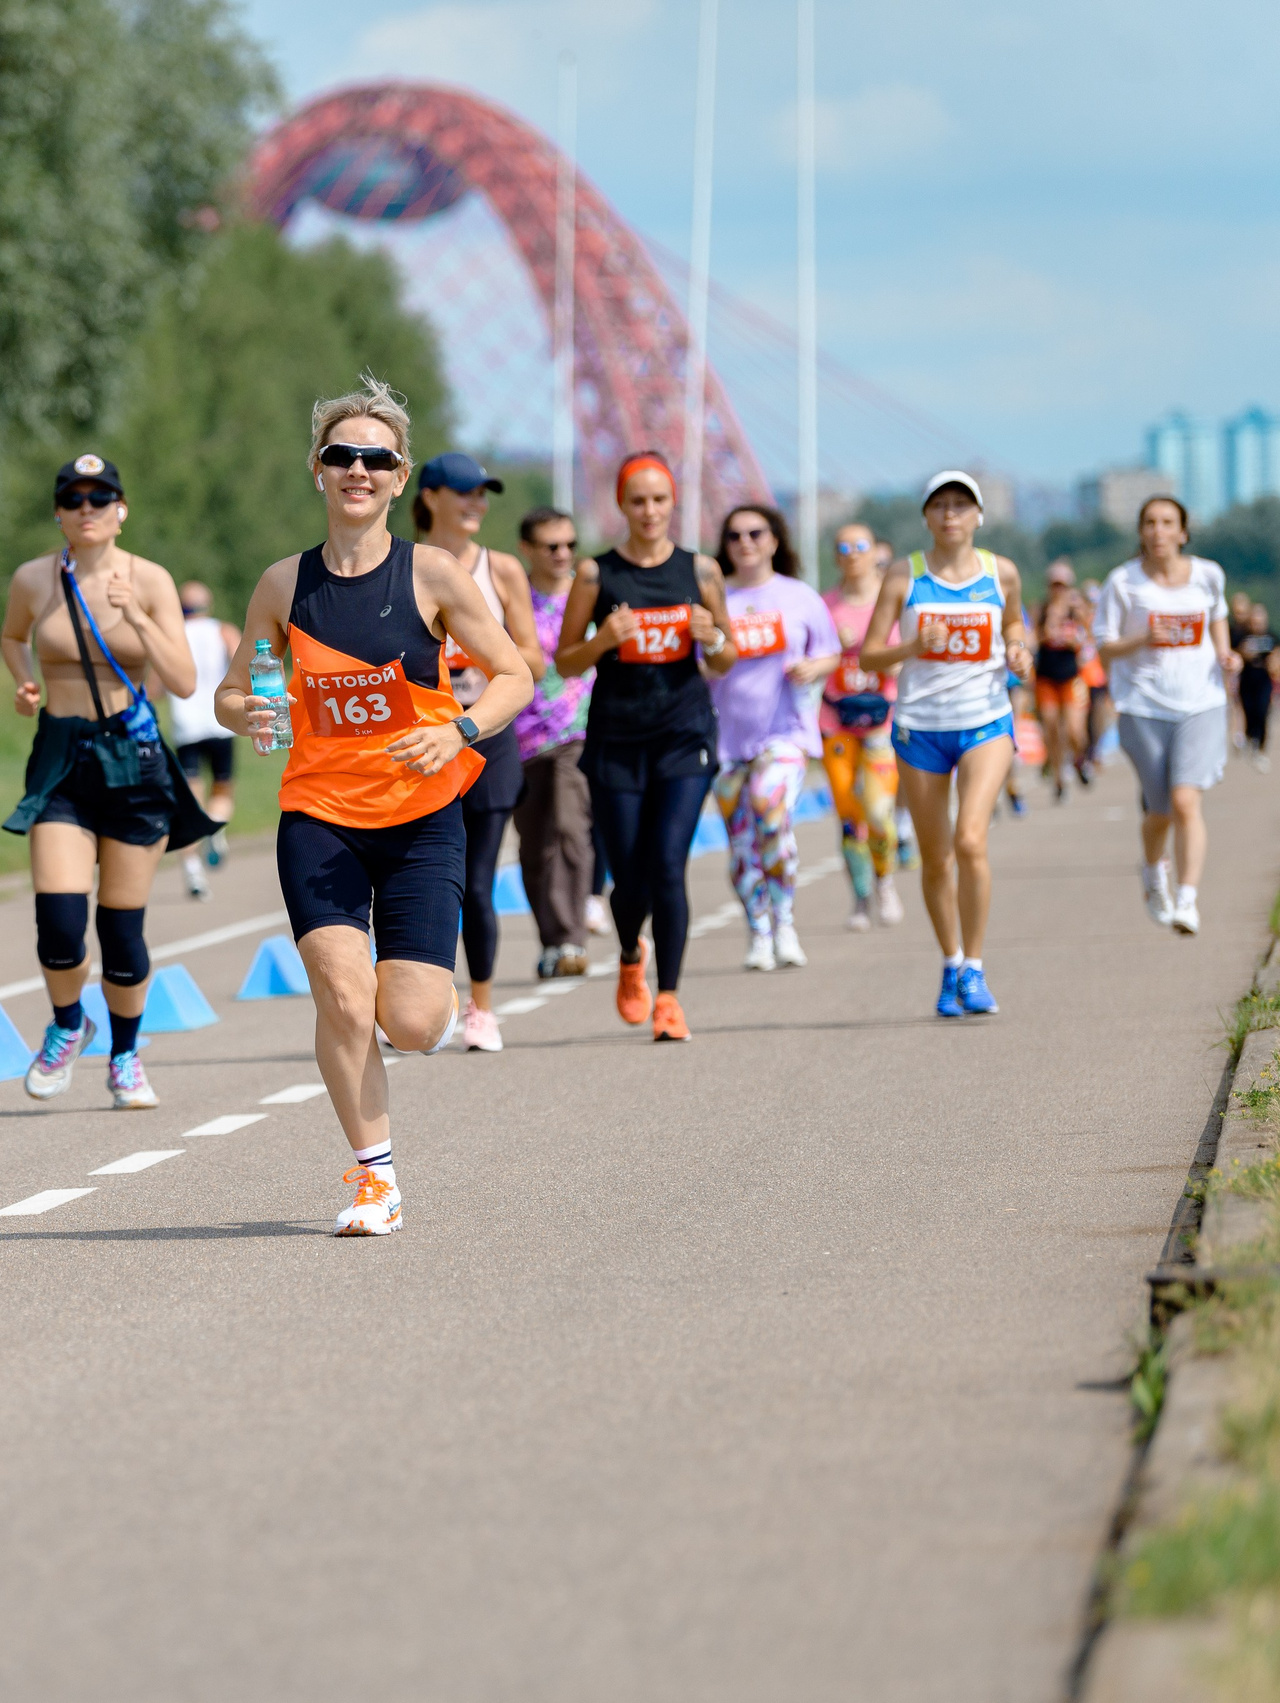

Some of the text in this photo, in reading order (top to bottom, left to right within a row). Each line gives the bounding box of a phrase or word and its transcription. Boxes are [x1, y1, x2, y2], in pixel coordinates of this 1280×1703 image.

[643, 606, 688, 625] ТОБОЙ
[636, 626, 681, 654] 124
[306, 666, 397, 690] Я С ТОБОЙ
[324, 693, 392, 725] 163
[354, 728, 361, 736] 5
